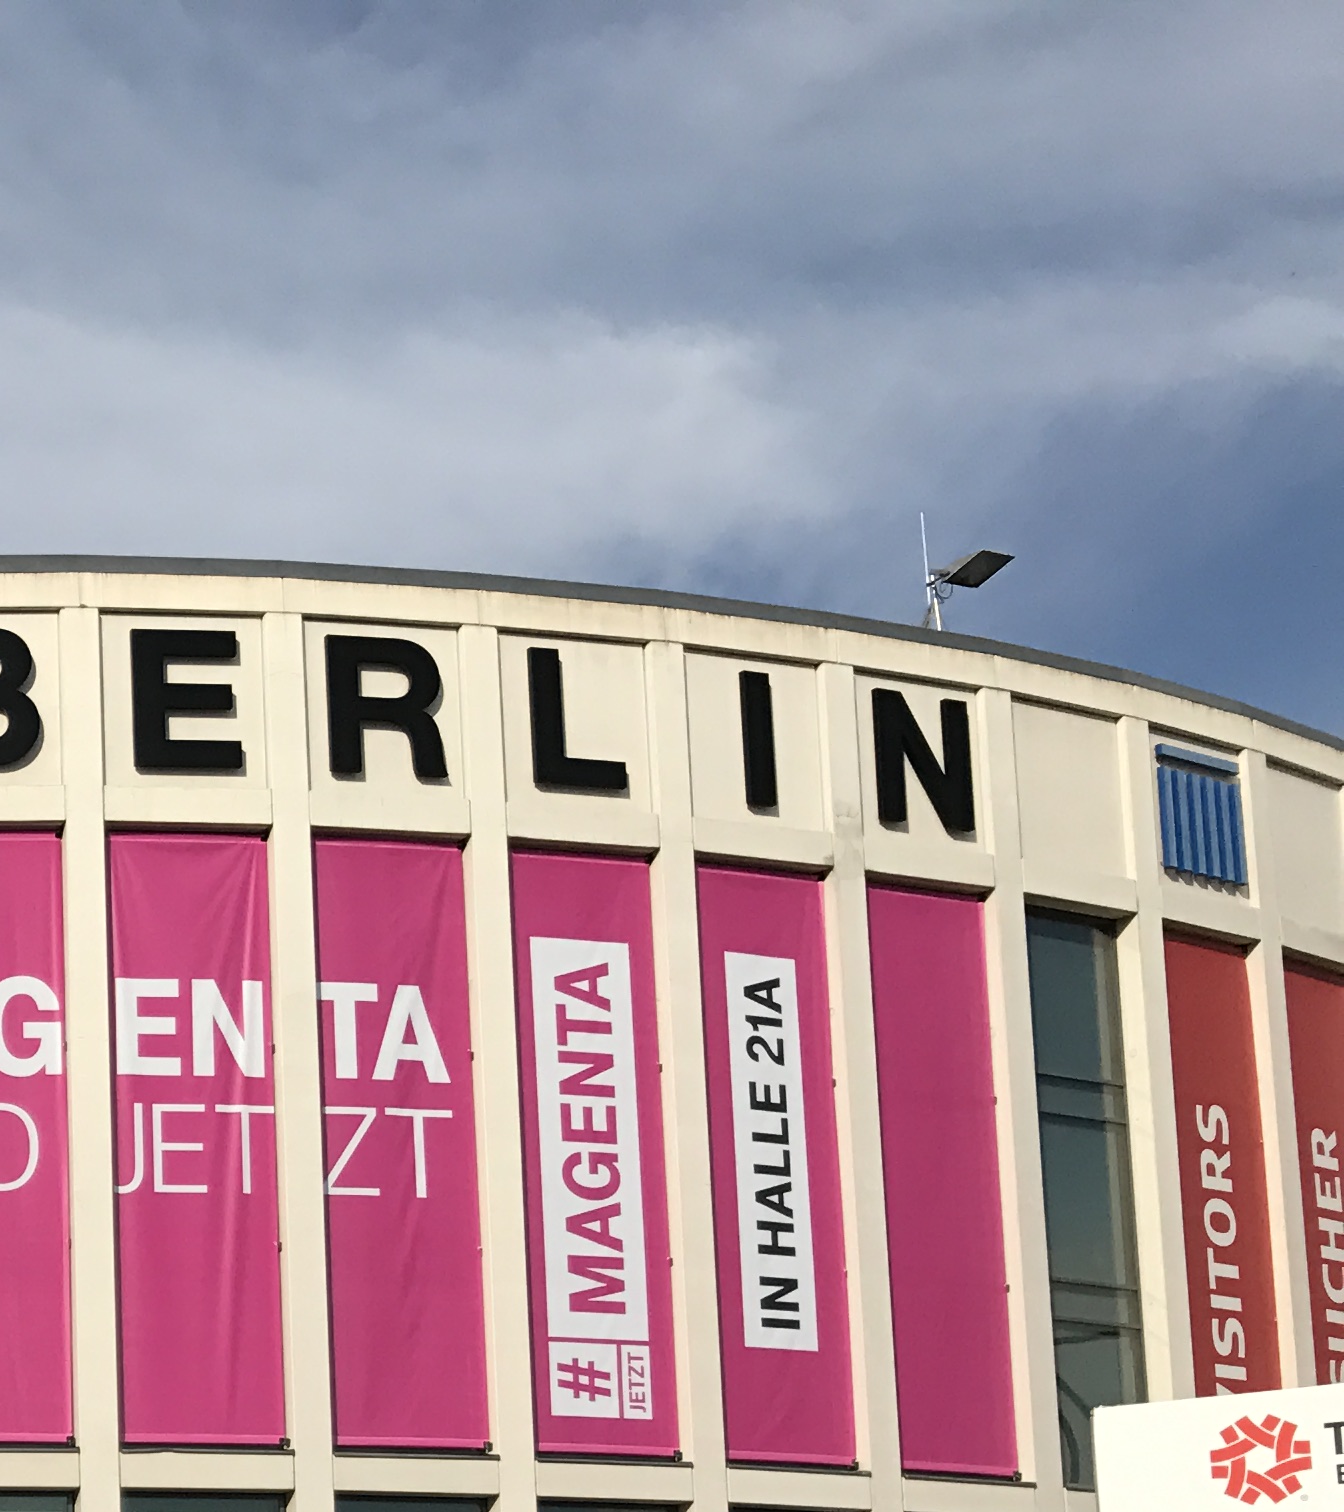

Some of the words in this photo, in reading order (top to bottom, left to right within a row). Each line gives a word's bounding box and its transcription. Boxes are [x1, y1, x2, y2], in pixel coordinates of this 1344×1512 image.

[744, 977, 785, 1067] 21A
[113, 1102, 453, 1199] JETZT
[554, 962, 627, 1315] MAGENTA
[749, 1081, 796, 1257] HALLE
[760, 1276, 801, 1330] IN
[628, 1351, 647, 1413] JETZT
